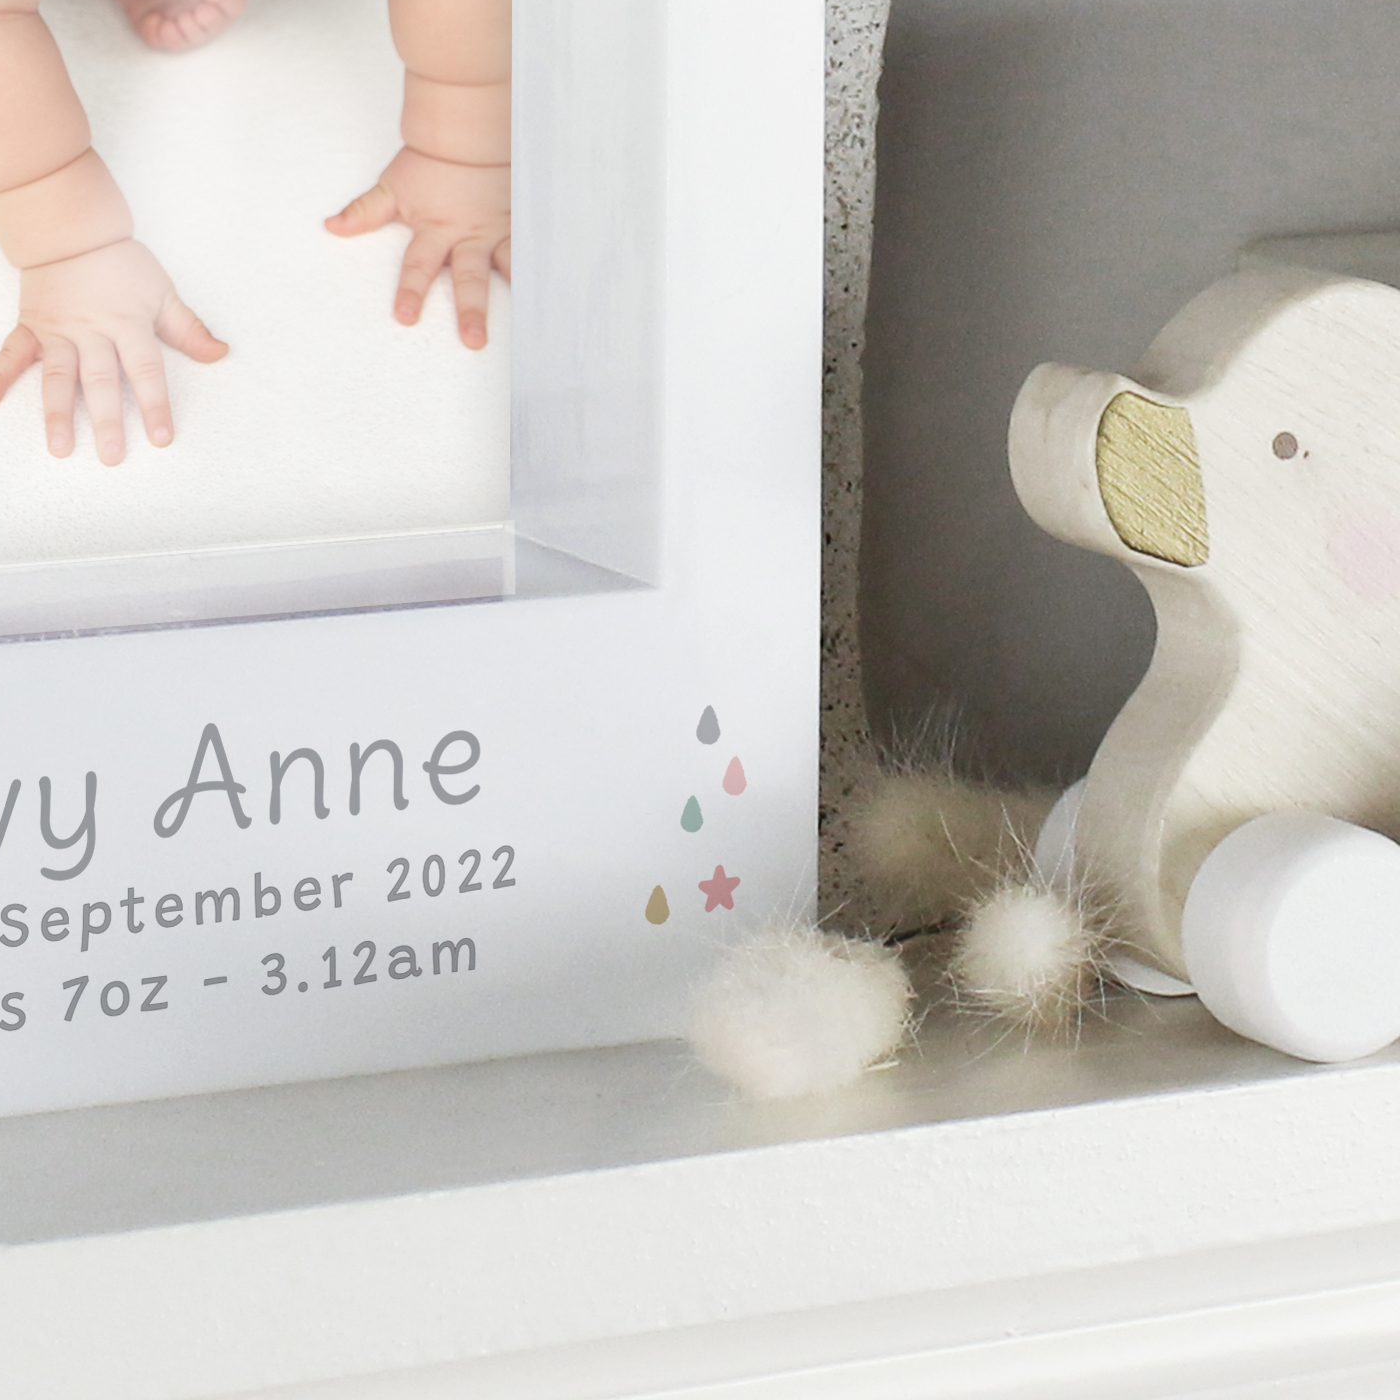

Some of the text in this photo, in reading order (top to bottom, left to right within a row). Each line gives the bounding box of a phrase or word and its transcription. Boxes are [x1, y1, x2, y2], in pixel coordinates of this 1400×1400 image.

[153, 722, 482, 839] Anne
[386, 844, 517, 903] 2022
[62, 974, 169, 1023] 7oz
[260, 937, 477, 996] 3.12am
